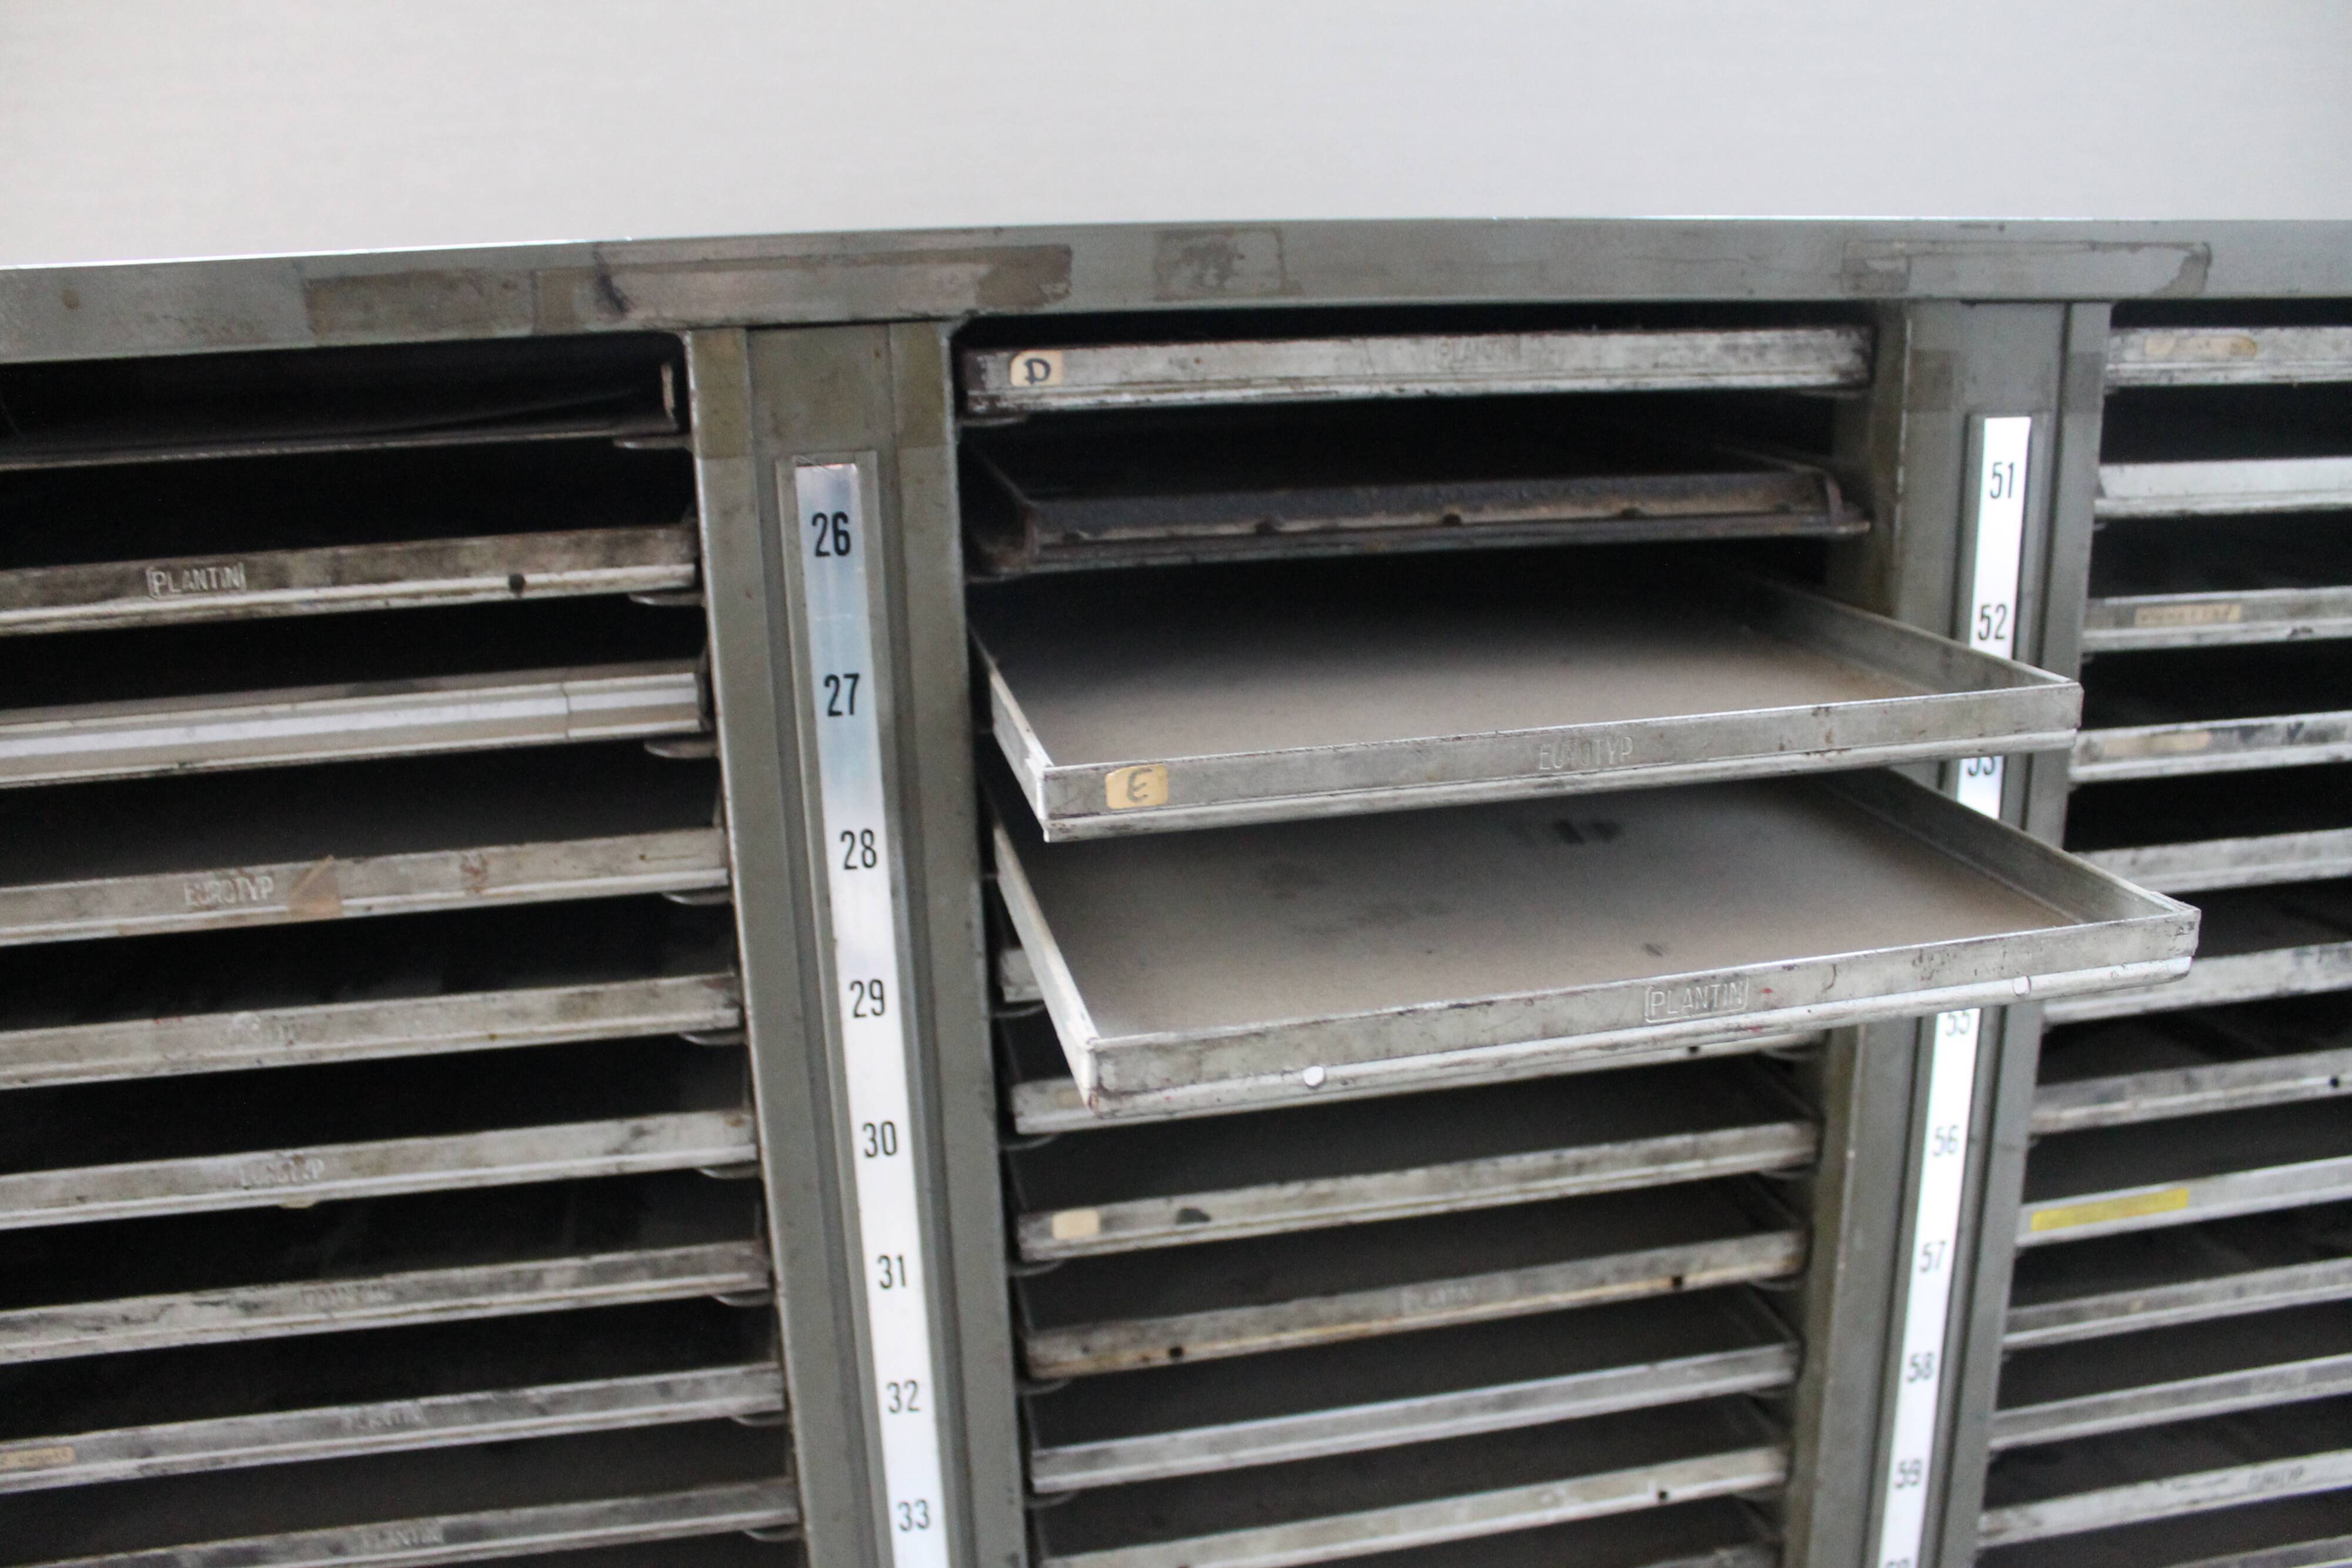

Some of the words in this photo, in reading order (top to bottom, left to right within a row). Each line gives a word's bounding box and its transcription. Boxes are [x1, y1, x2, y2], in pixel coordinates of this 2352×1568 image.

[1024, 356, 1051, 384] D
[1990, 462, 2015, 499] 51
[811, 511, 851, 557] 26
[151, 564, 240, 597] PLANTIN
[1978, 604, 2007, 641] 52
[824, 673, 860, 717] 27
[1125, 767, 1152, 803] E
[840, 828, 877, 870] 28
[850, 979, 886, 1018] 29
[1649, 981, 1745, 1017] PLANTIN
[863, 1121, 897, 1158] 30
[1930, 1124, 1960, 1158] 56
[877, 1255, 906, 1289] 31
[1918, 1240, 1947, 1273] 57
[1906, 1352, 1936, 1383] 58
[888, 1380, 920, 1413] 32
[1893, 1458, 1922, 1489] 59
[898, 1499, 930, 1532] 33
